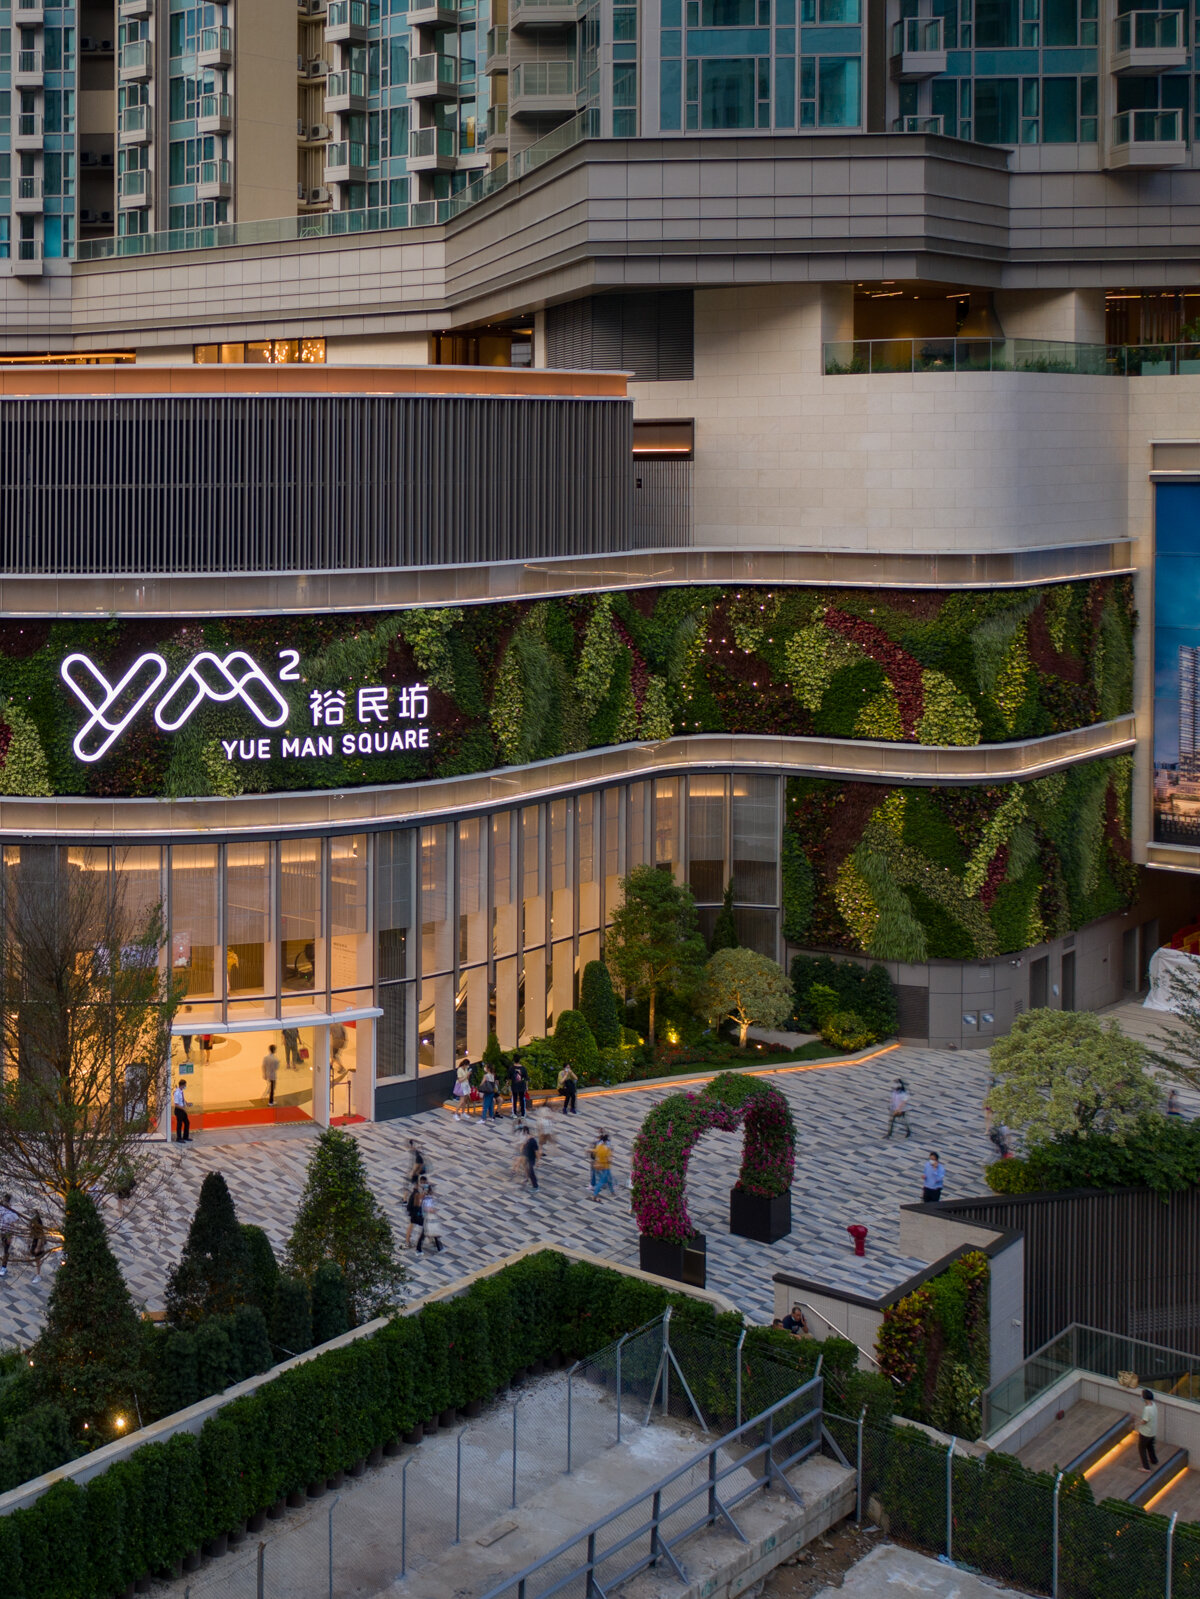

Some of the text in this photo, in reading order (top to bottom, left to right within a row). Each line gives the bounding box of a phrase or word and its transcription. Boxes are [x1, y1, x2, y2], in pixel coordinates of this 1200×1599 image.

[309, 682, 430, 727] 裕民坊
[221, 727, 430, 761] YUE MAN SQUARE
